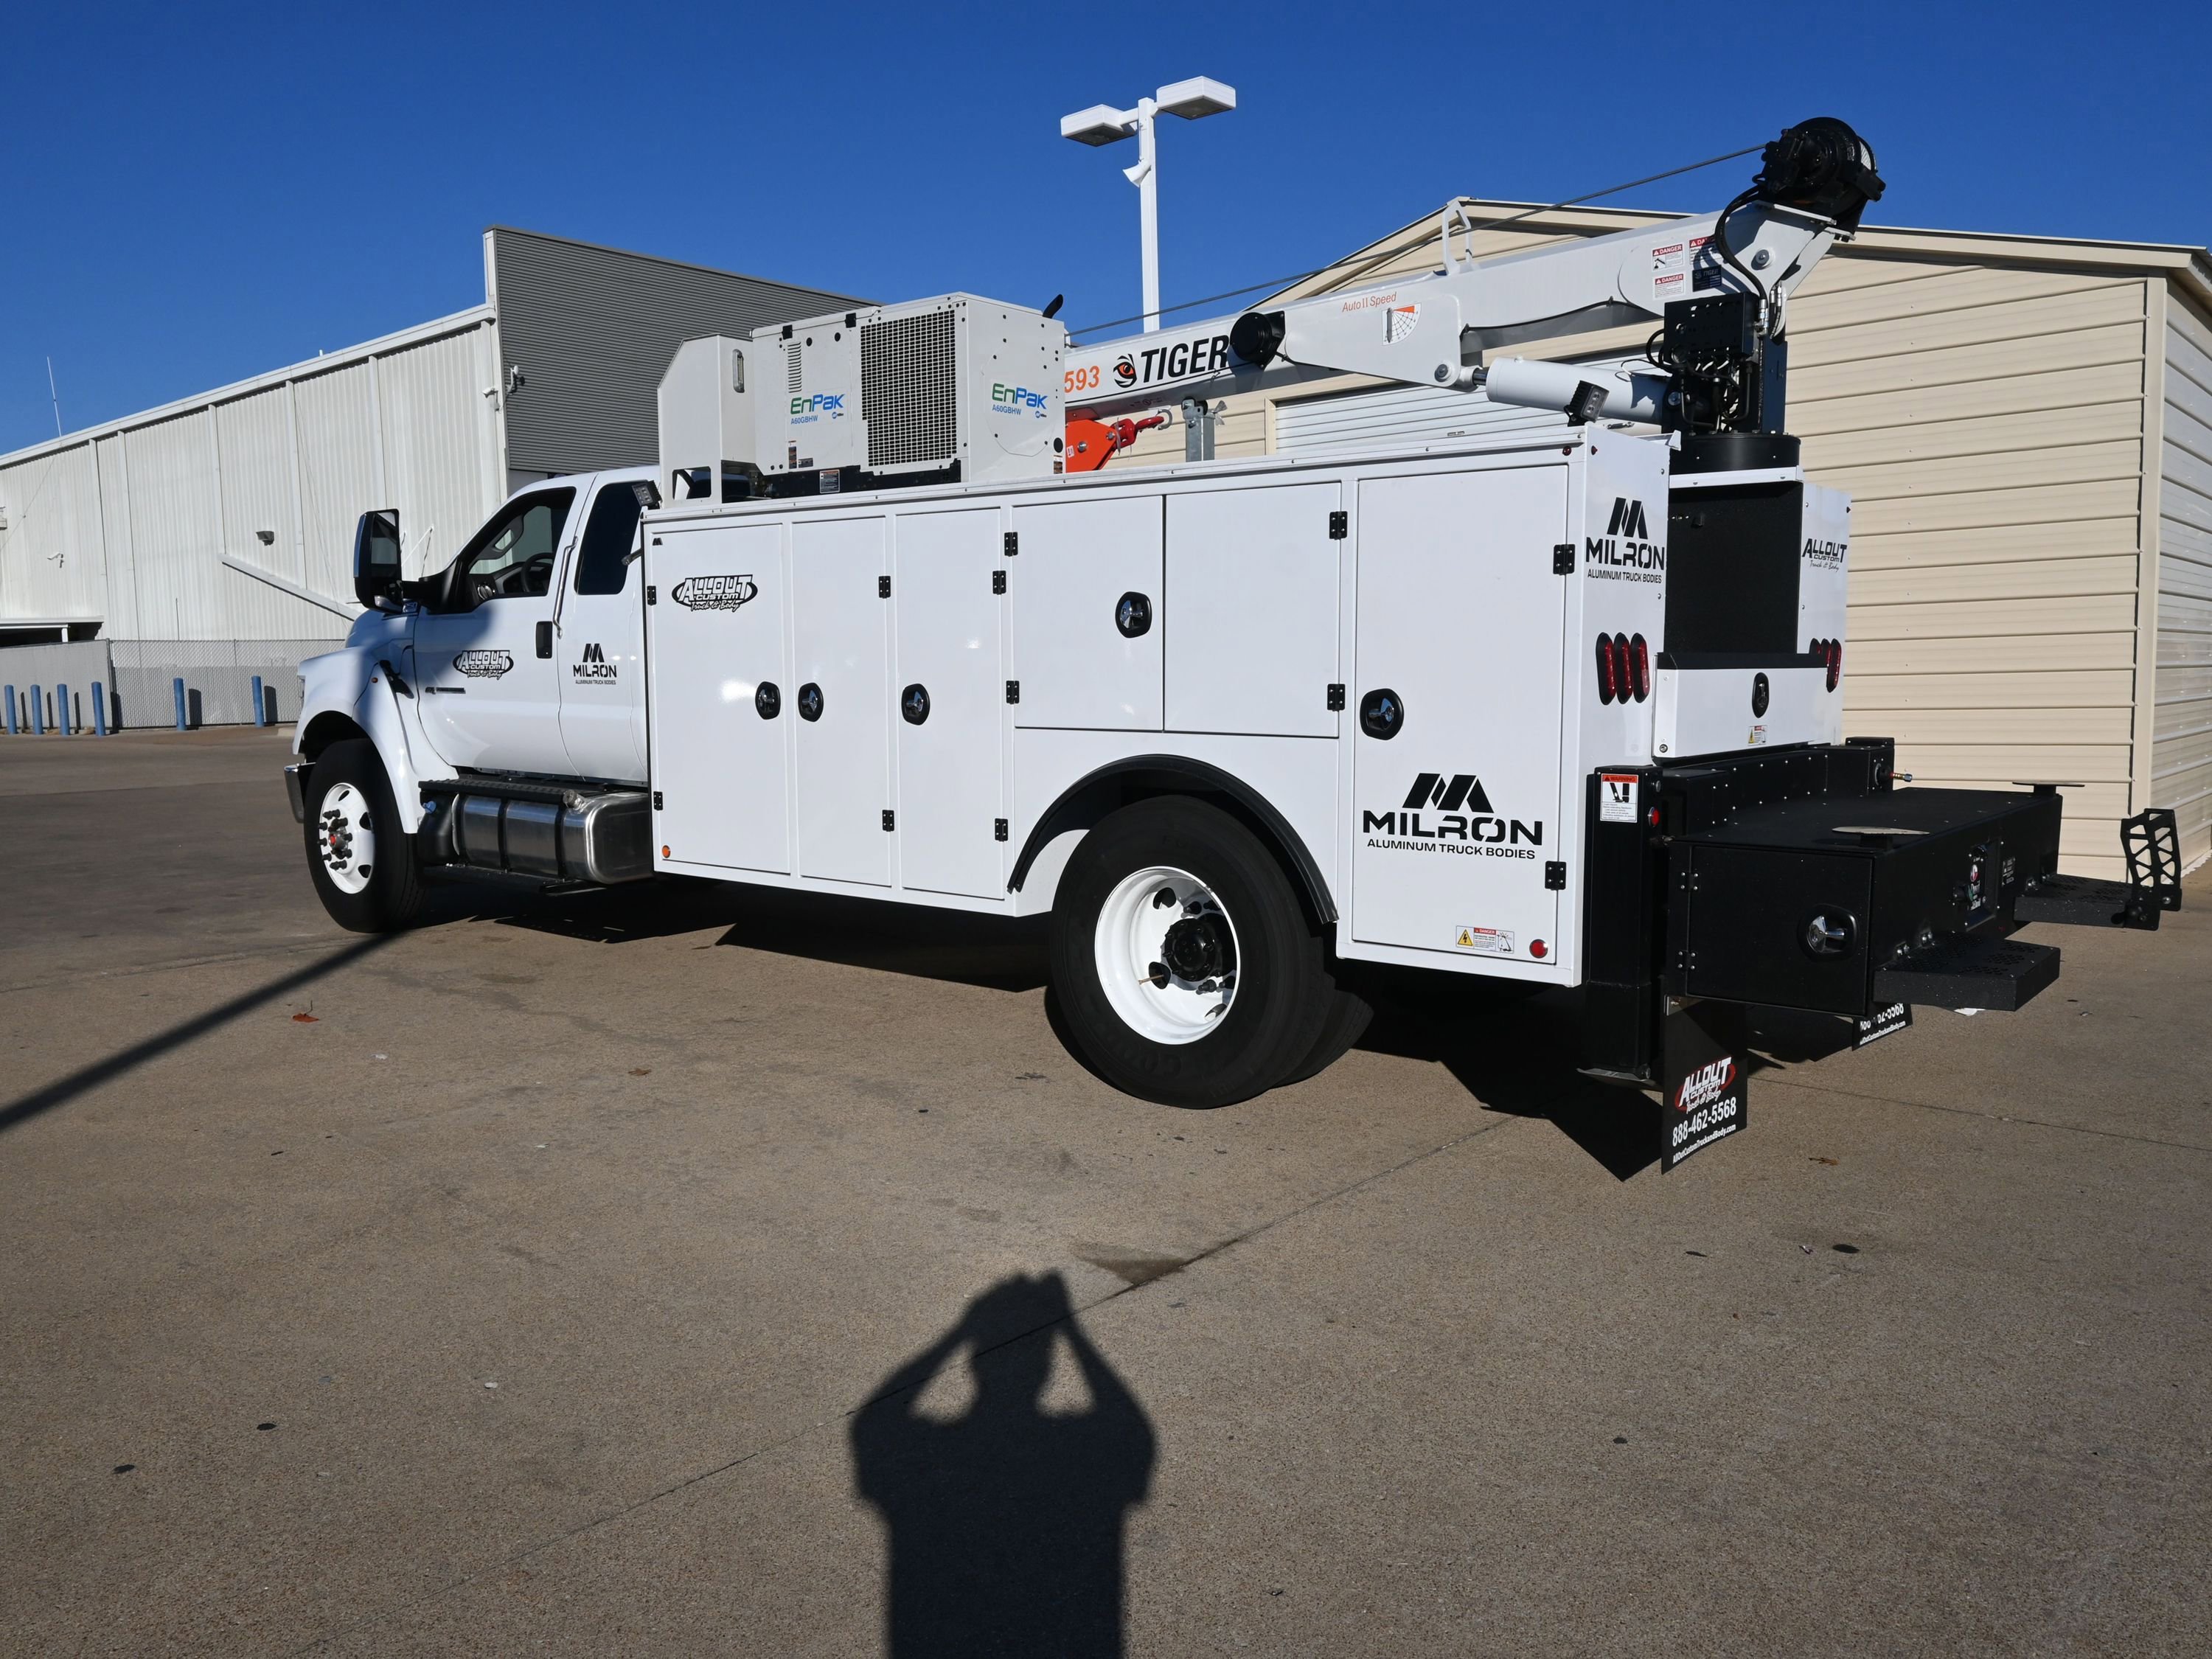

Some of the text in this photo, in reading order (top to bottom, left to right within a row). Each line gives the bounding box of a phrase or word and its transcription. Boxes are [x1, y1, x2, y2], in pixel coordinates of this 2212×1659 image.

[1659, 245, 1682, 254] DANGER
[1661, 275, 1683, 283] DANGER
[1342, 302, 1361, 313] Auto
[1369, 291, 1397, 307] Speed
[1141, 335, 1230, 383] TIGER
[790, 394, 845, 414] EnPak
[992, 383, 1048, 409] EnPak
[992, 404, 1022, 415] A60GBHW
[790, 415, 818, 425] A60GBHW
[1585, 537, 1665, 571] MILRON
[1801, 538, 1848, 563] ALLOUT
[1813, 554, 1840, 563] CUSTOM
[1587, 568, 1662, 584] ALUMINUM TRUCK BODIES
[678, 575, 753, 602] ALLOUT
[695, 593, 739, 601] CUSTOM
[720, 599, 740, 613] Body
[457, 650, 510, 670] ALLOUT
[572, 664, 617, 678] MILRON
[1363, 810, 1543, 846] MILRON
[1367, 838, 1536, 860] ALUMINUM TRUCK BODIES
[1678, 1057, 1732, 1107] ALLOUT
[1690, 1079, 1721, 1099] CUSTOM
[1672, 1096, 1737, 1147] 888-462-5568
